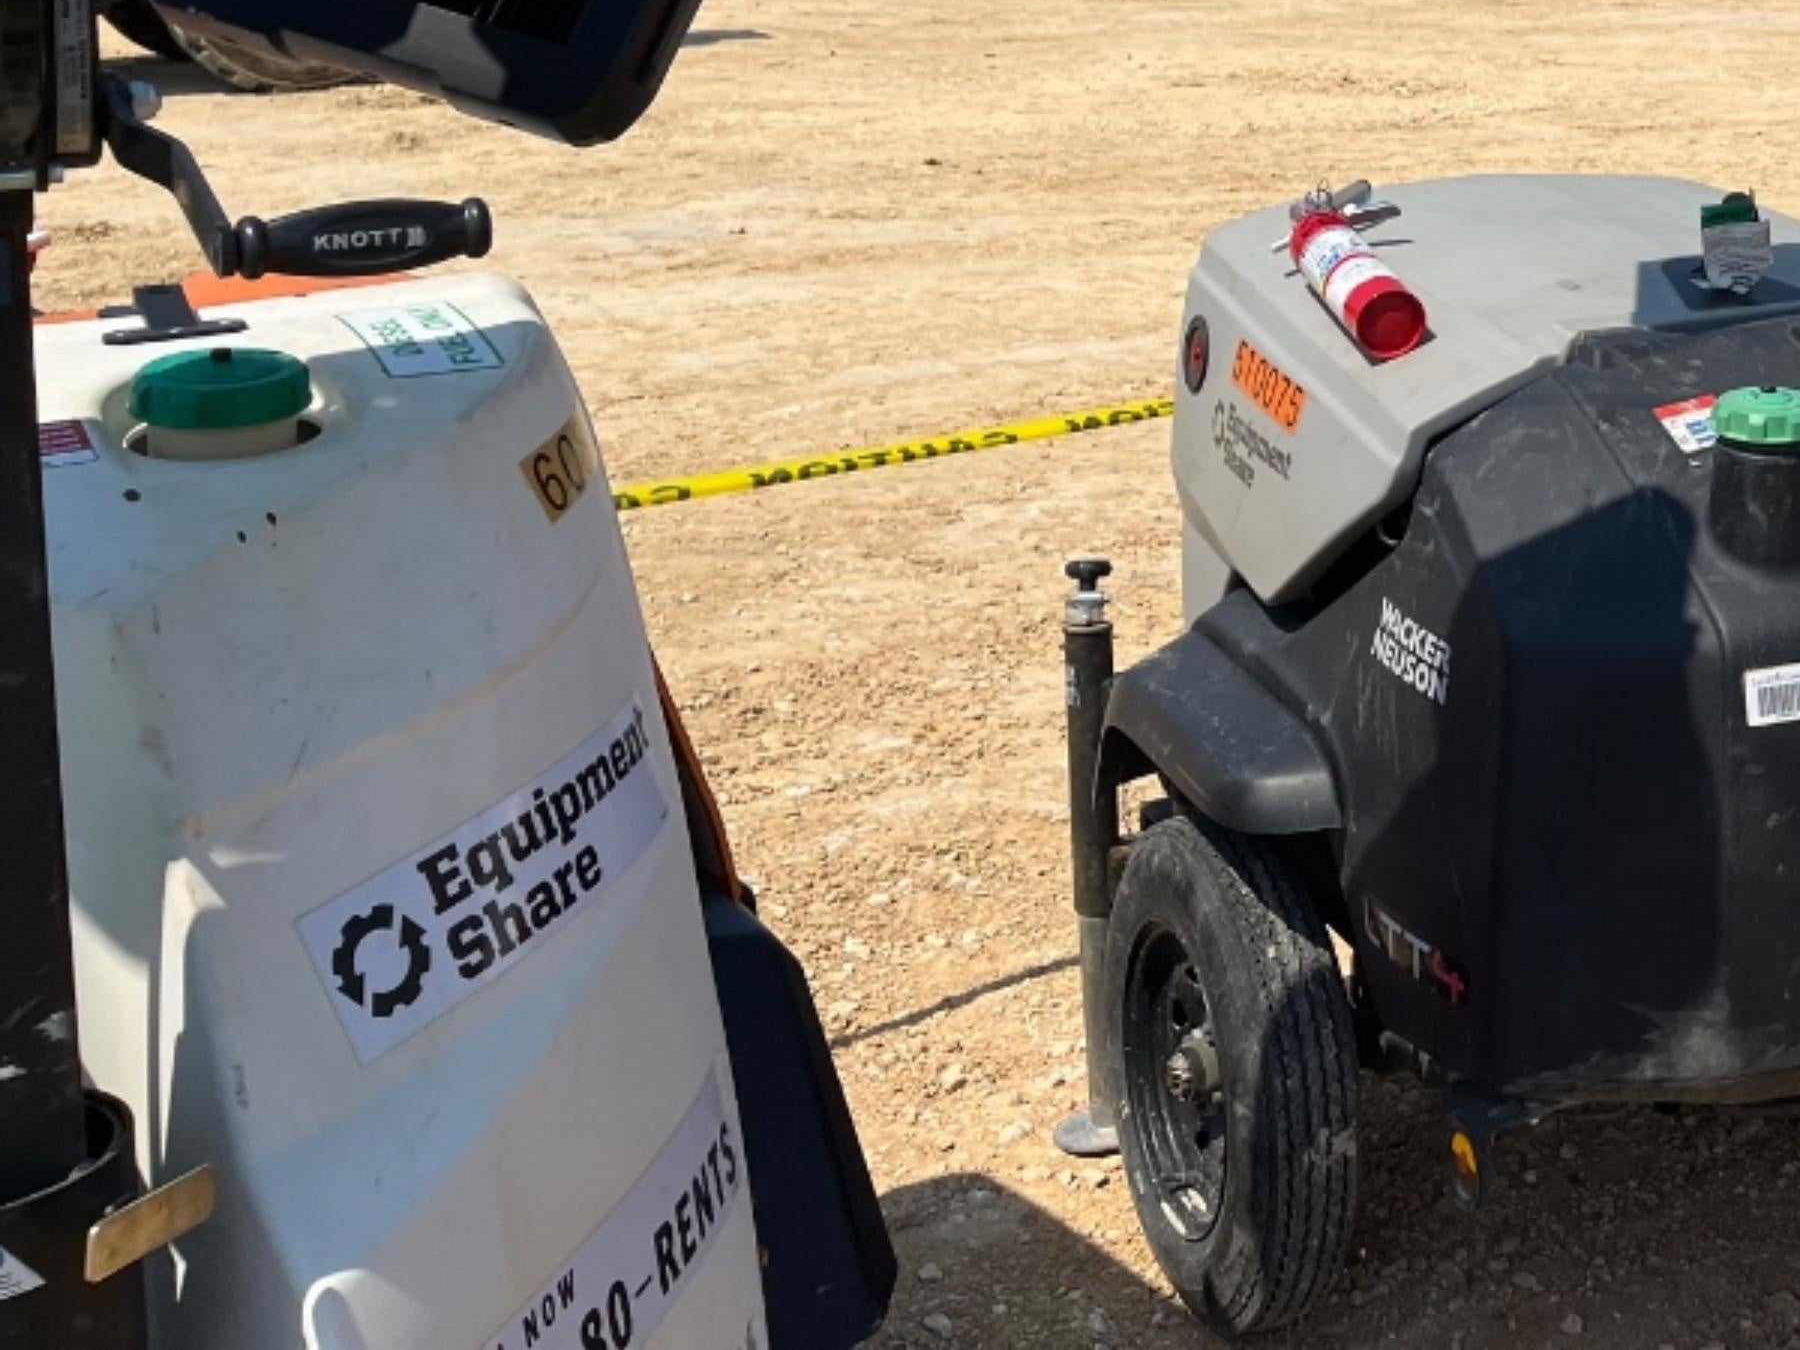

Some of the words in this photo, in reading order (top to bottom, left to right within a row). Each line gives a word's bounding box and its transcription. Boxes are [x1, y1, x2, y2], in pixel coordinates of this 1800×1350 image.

[313, 227, 404, 250] KNOTT
[533, 434, 586, 511] 60
[1370, 627, 1449, 706] NEUSON
[1380, 596, 1451, 675] WACKER
[416, 705, 649, 916] Equipment
[447, 844, 602, 979] Share
[522, 1268, 575, 1348] NOW
